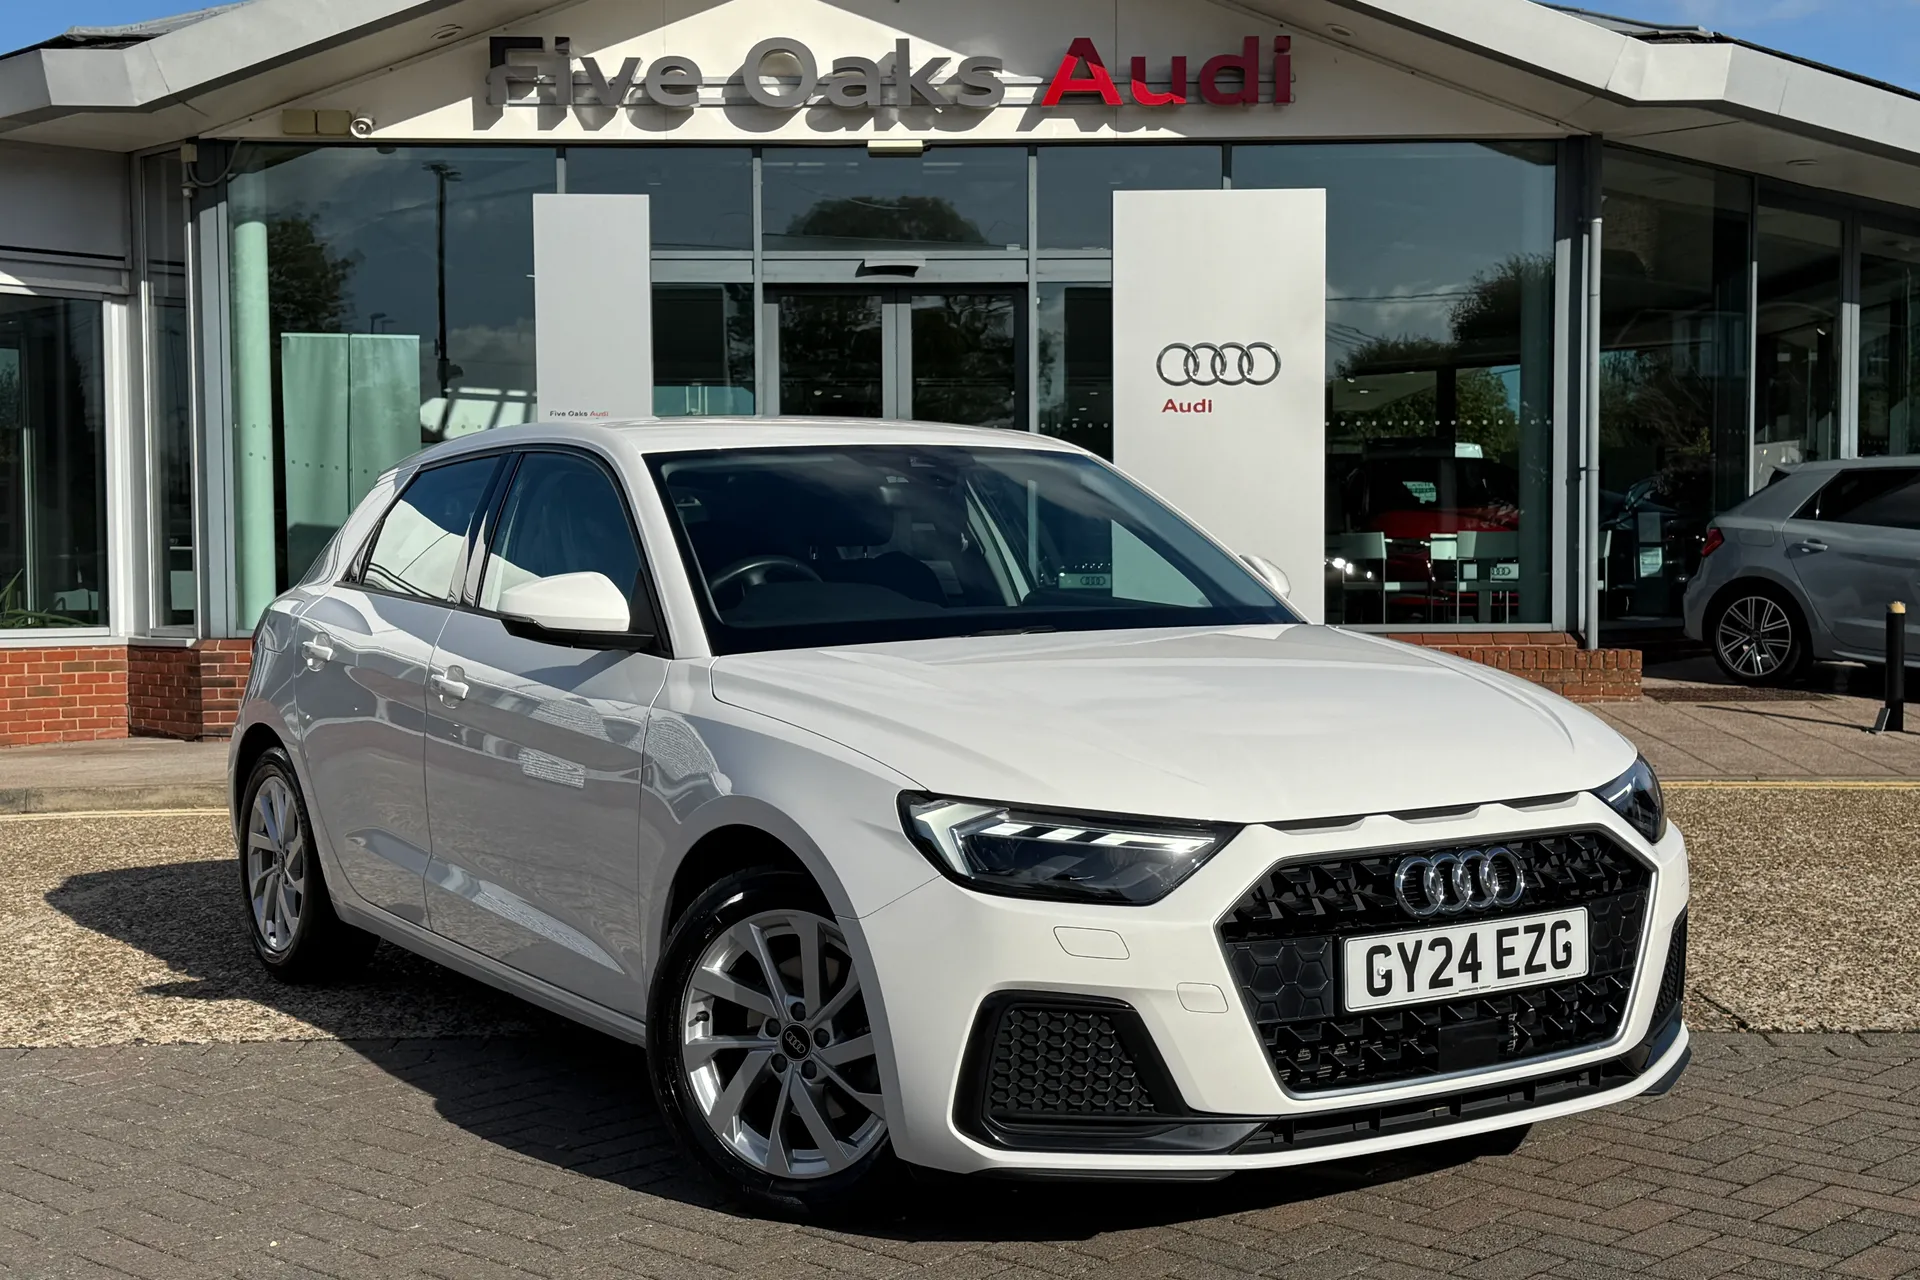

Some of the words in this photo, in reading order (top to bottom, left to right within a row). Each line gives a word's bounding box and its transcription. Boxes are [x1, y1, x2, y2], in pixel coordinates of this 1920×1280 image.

[488, 36, 702, 107] Five
[742, 37, 1006, 108] Oaks
[1041, 35, 1292, 106] Audi
[1162, 398, 1213, 413] Audi
[1366, 933, 1481, 997] GY24
[1496, 920, 1572, 979] EZG
